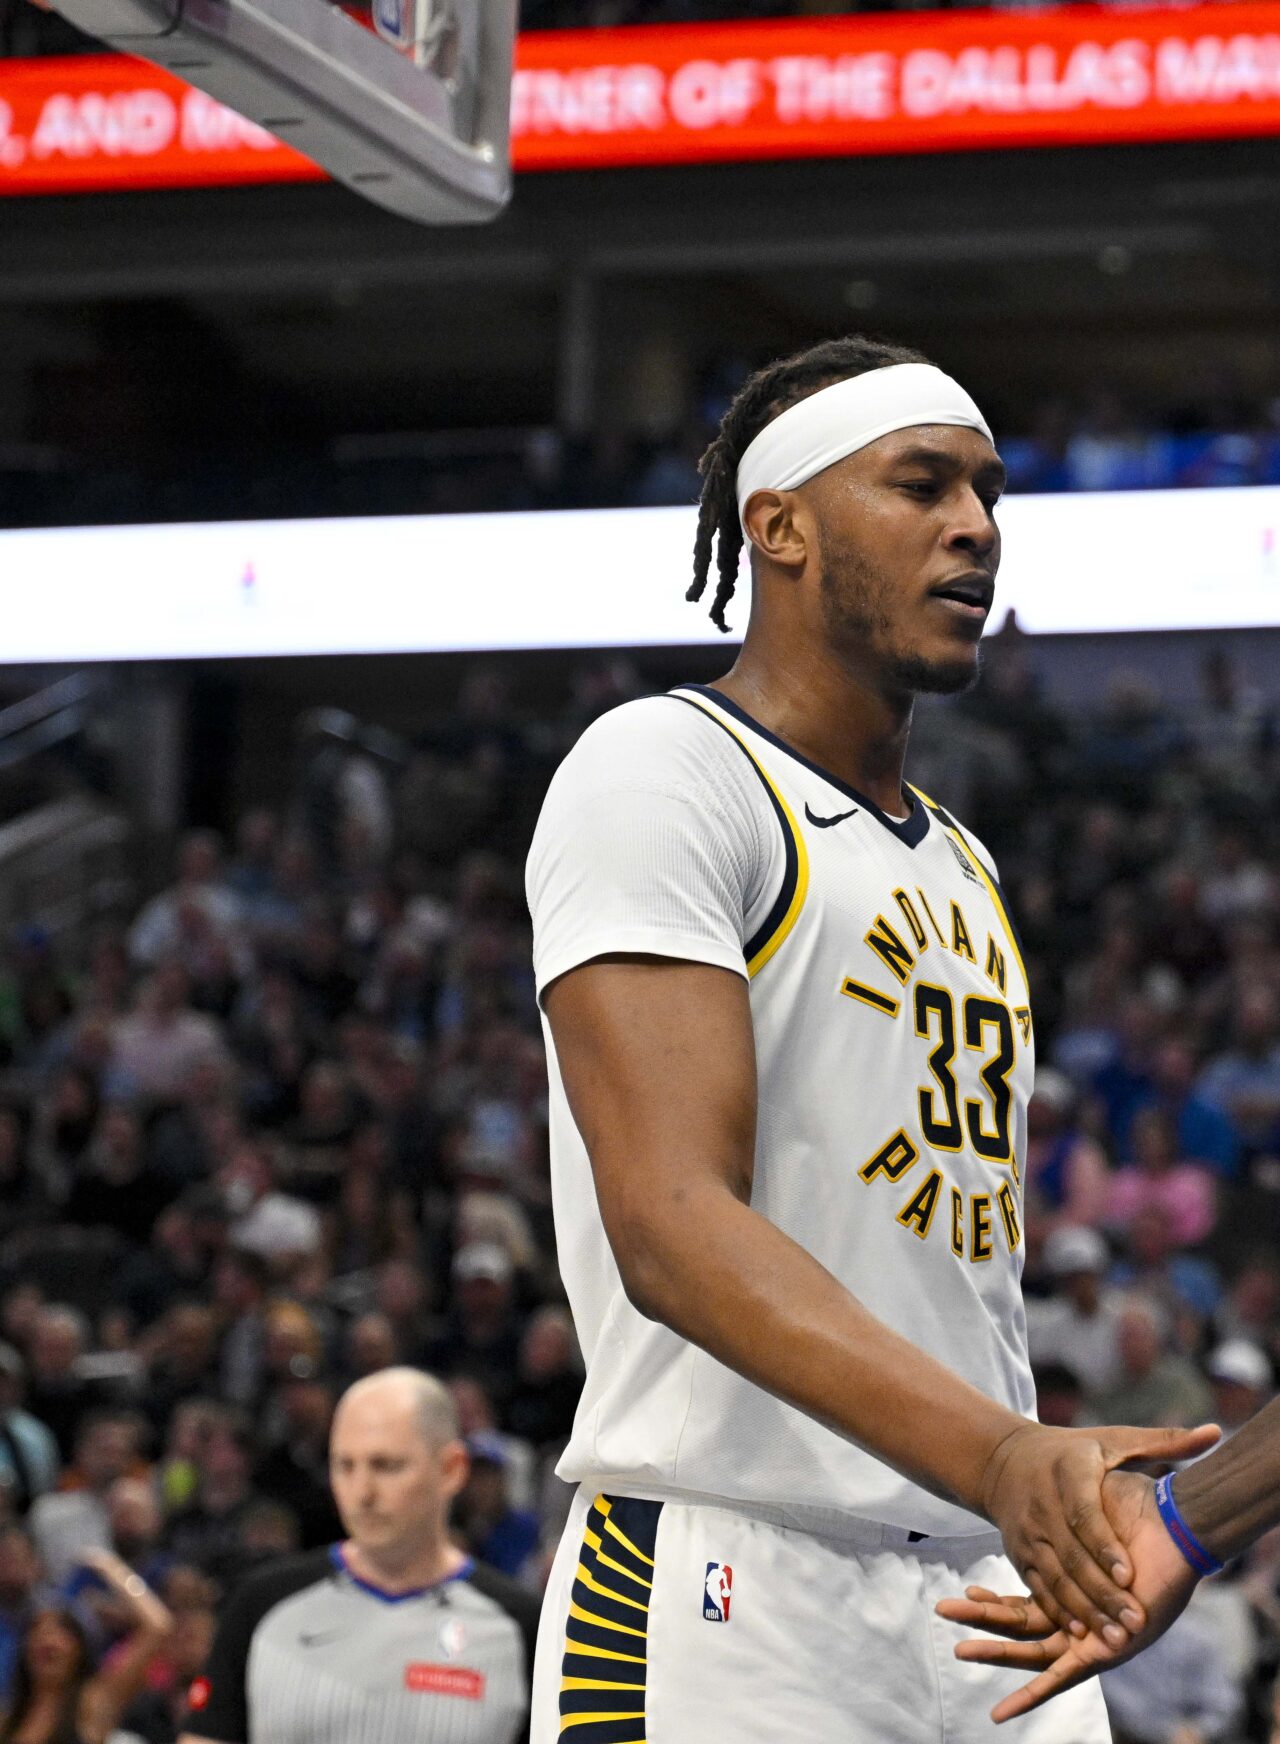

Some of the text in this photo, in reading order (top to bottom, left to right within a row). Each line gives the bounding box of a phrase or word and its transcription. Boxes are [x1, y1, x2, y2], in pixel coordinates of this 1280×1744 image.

[31, 90, 177, 159] AND
[668, 59, 762, 129] OF
[768, 53, 896, 123] THE
[902, 38, 1150, 118] DALLAS
[840, 887, 1032, 1047] INDIANA
[913, 981, 1015, 1165] 33
[858, 1127, 1021, 1263] PACER
[705, 1608, 720, 1620] NBA
